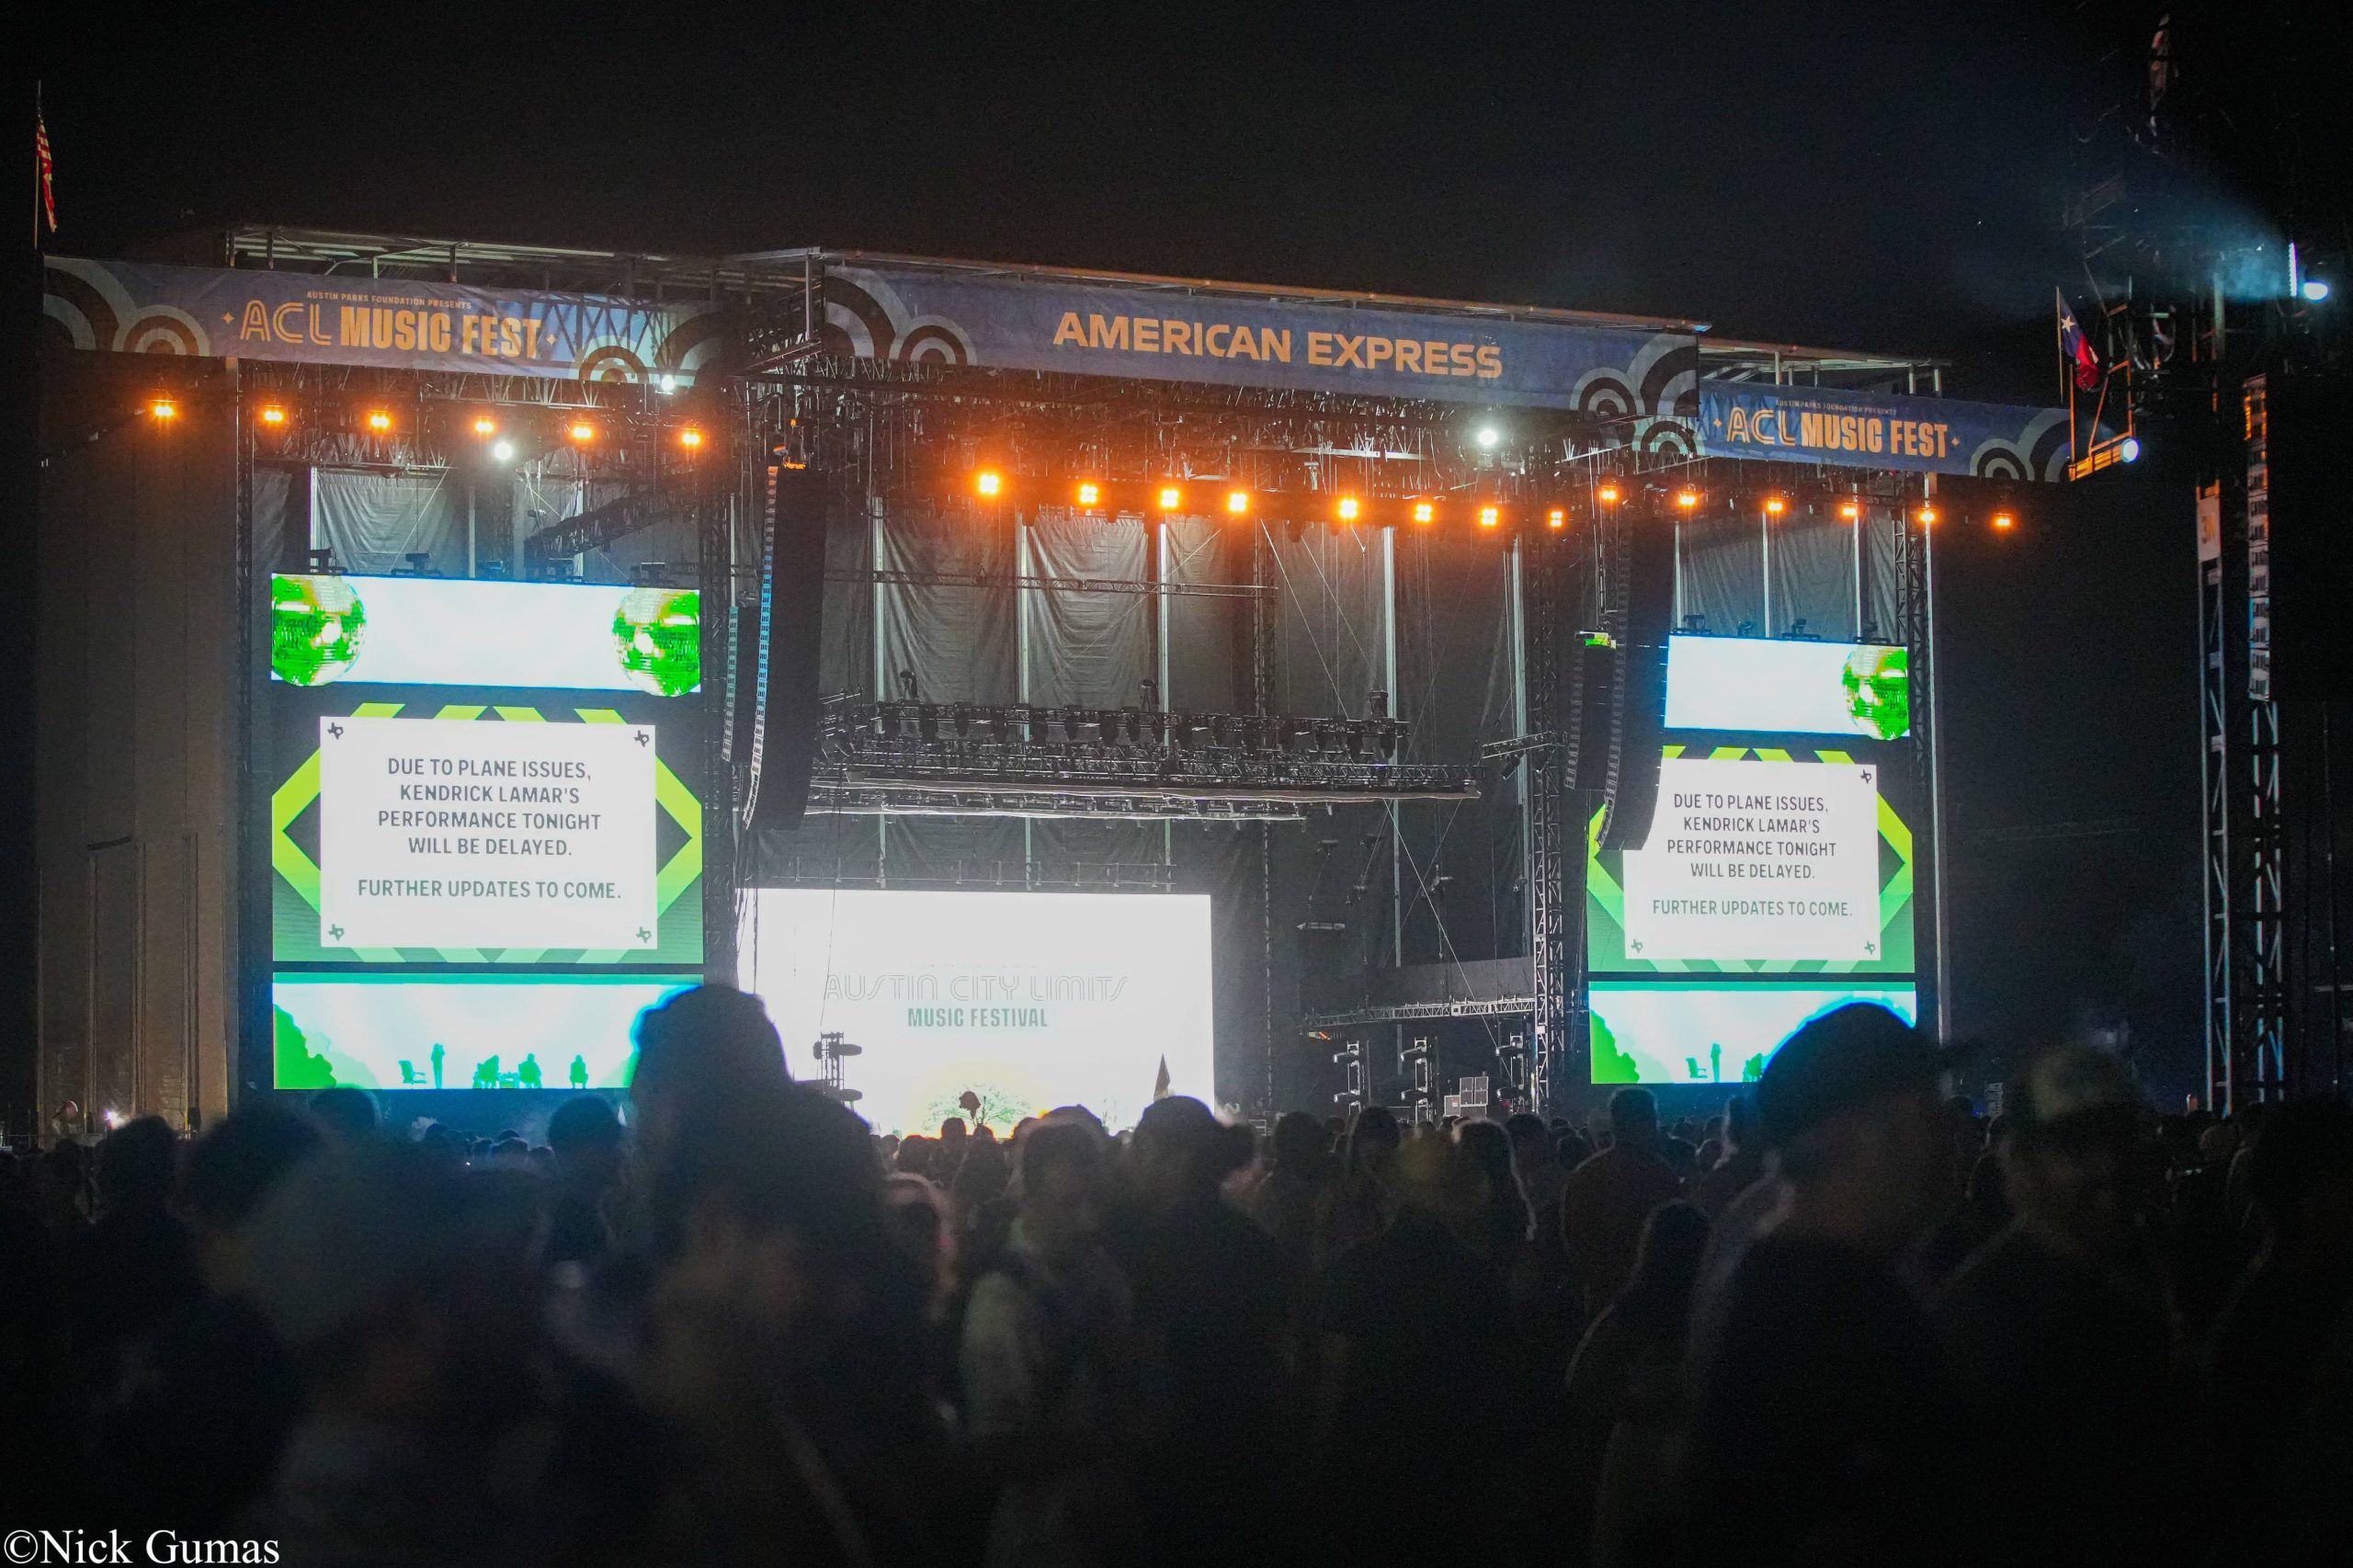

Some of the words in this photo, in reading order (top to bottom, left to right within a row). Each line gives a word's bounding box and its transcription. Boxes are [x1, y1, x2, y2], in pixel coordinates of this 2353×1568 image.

[307, 290, 338, 300] AUSTIN
[341, 293, 369, 301] PARKS
[371, 295, 426, 306] FOUNDATION
[427, 300, 472, 310] PRESENTS
[240, 300, 331, 346] ACL
[340, 305, 451, 353] MUSIC
[462, 314, 541, 360] FEST
[1052, 312, 1290, 364] AMERICAN
[1308, 331, 1503, 379] EXPRESS
[1726, 406, 1796, 447] ACL
[1802, 411, 1881, 451] MUSIC
[1891, 419, 1949, 458] FEST
[388, 757, 425, 776] DUE
[430, 758, 453, 776] TO
[458, 759, 517, 778] PLANE
[522, 760, 592, 782] ISSUES,
[400, 784, 494, 803] KENDRICK
[499, 786, 580, 804] LAMAR'S
[1674, 793, 1702, 809] DUE
[1705, 794, 1723, 810] TO
[1727, 794, 1772, 811] PLANE
[1776, 795, 1829, 814] ISSUES,
[378, 811, 517, 829] PERFORMANCE
[522, 812, 601, 830] TONIGHT
[1684, 816, 1755, 833] KENDRICK
[1758, 818, 1820, 834] LAMAR'S
[408, 837, 452, 855] WILL
[457, 837, 481, 855] BE
[485, 837, 573, 857] DELAYED.
[1667, 840, 1773, 856] PERFORMANCE
[1777, 841, 1836, 857] TONIGHT
[1690, 862, 1724, 878] WILL
[1728, 863, 1745, 879] BE
[1749, 863, 1815, 880] DELAYED.
[358, 879, 442, 897] FURTHER
[448, 880, 531, 898] UPDATES
[536, 881, 559, 898] TO
[563, 881, 621, 899] COME.
[1653, 899, 1718, 915] FURTHER
[1722, 900, 1784, 916] UPDATES
[1788, 901, 1806, 916] TO
[1809, 901, 1853, 917] COME.
[824, 974, 938, 1001] AUSTIN
[950, 975, 1019, 1001] CITY
[1030, 975, 1128, 1002] LIMITS
[907, 1007, 964, 1028] MUSIC
[971, 1007, 1048, 1028] FESTIVAL
